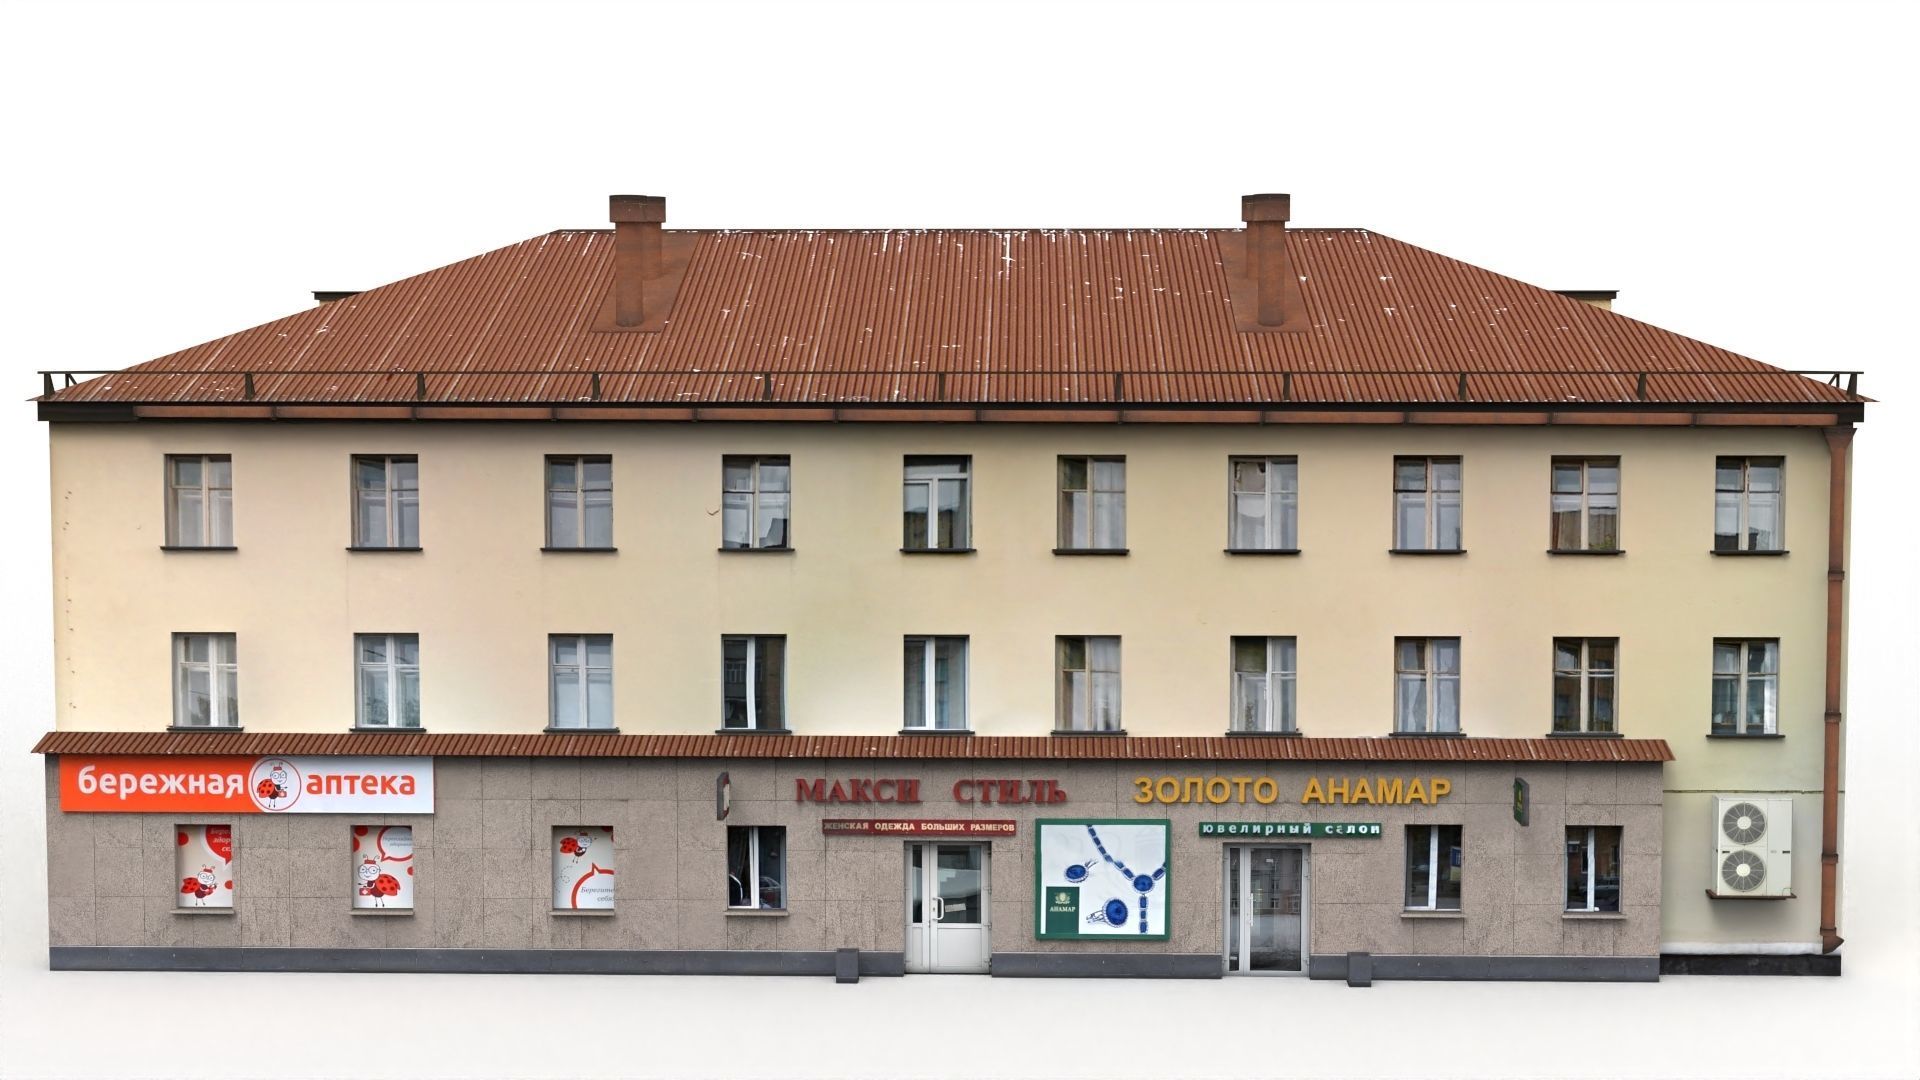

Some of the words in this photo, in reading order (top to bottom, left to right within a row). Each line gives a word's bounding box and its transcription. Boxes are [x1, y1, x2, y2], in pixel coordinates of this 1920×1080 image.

[78, 765, 243, 799] бережная
[306, 774, 416, 796] аптека
[796, 779, 920, 804] МАКСИ
[954, 780, 1067, 804] СТИЛЬ
[1134, 776, 1279, 805] ЗОЛОТО
[1301, 778, 1451, 805] АНАМАР
[824, 822, 869, 830] ЖЕНСКАЯ
[874, 822, 915, 831] ОДЕЖДА
[921, 822, 965, 832] БОЛЬШИХ
[970, 823, 1015, 832] РАЗМЕРОВ
[1203, 823, 1312, 836] ювелирный
